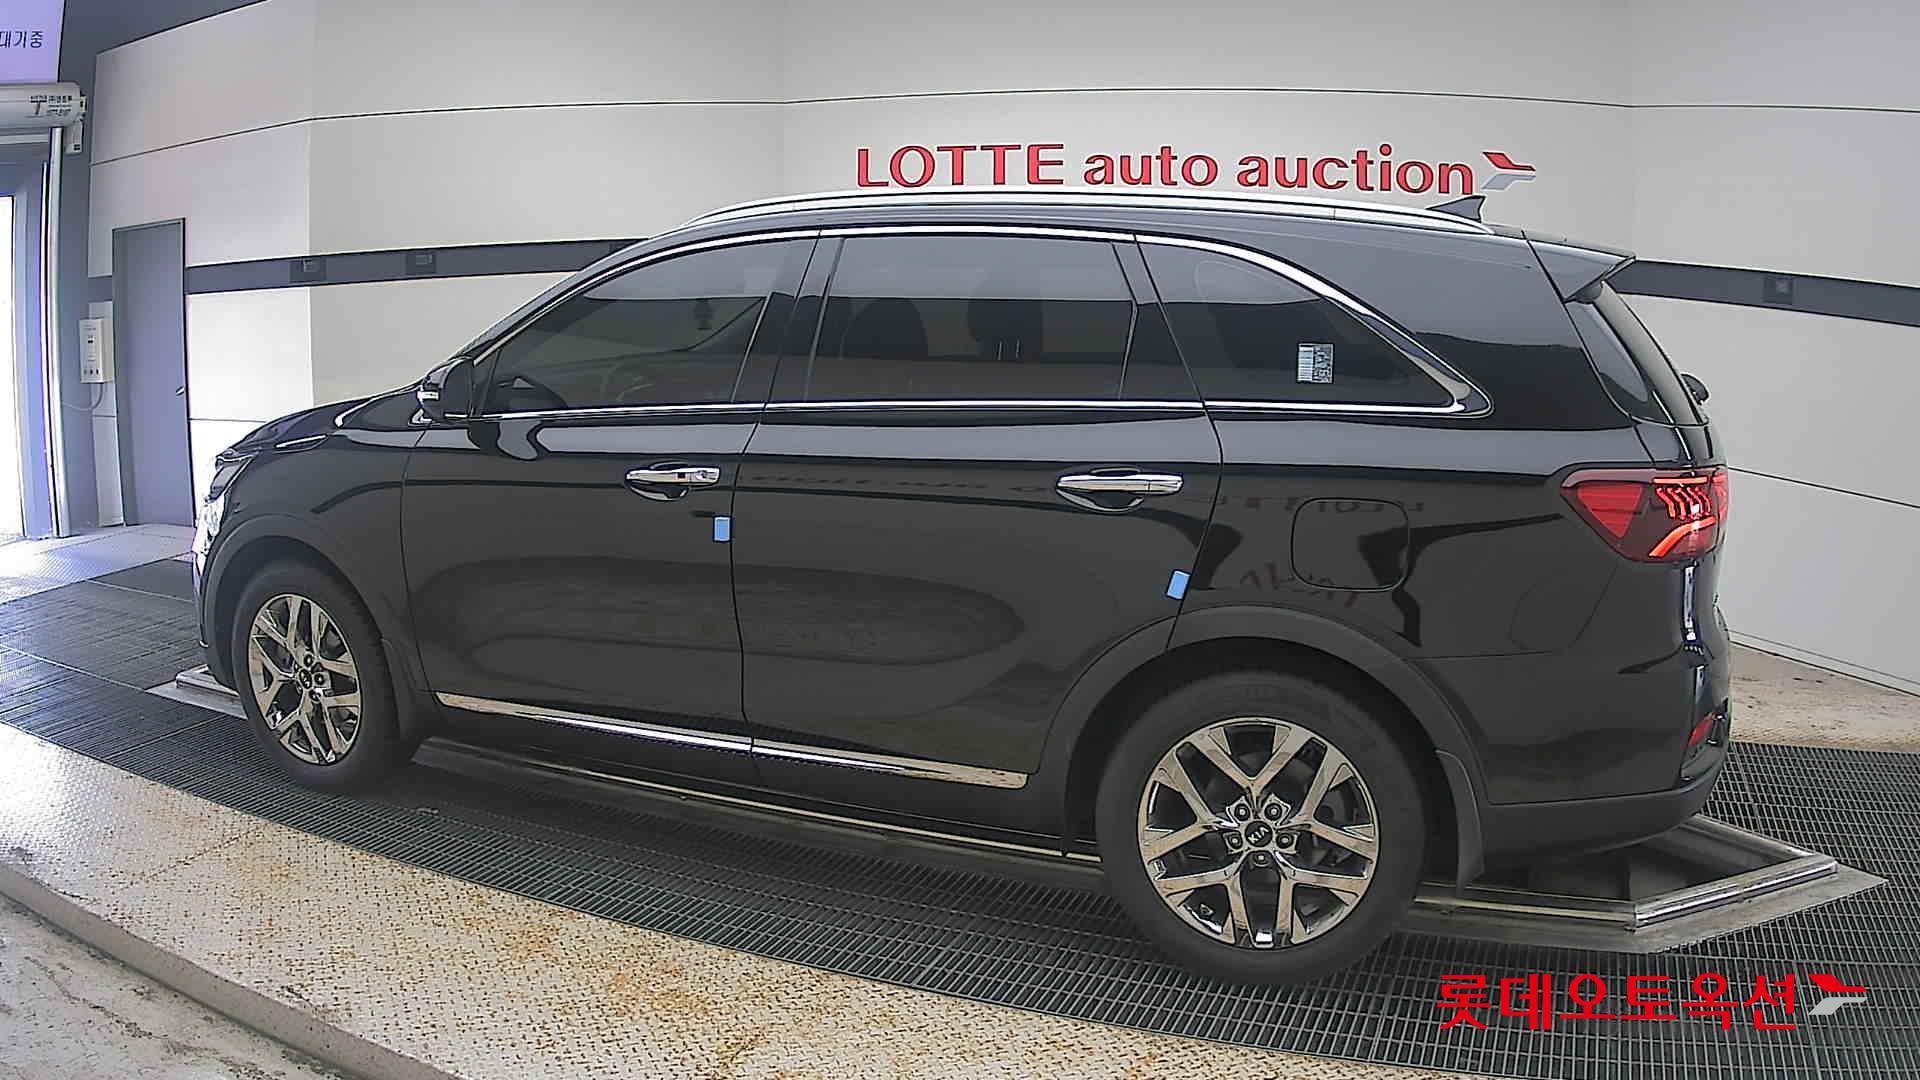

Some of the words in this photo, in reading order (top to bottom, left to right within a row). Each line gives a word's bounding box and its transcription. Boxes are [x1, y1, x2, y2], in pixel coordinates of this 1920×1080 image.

[857, 143, 1065, 188] LOTTE
[1083, 145, 1219, 187] auto
[1236, 143, 1474, 196] auction
[1247, 826, 1270, 844] KIA
